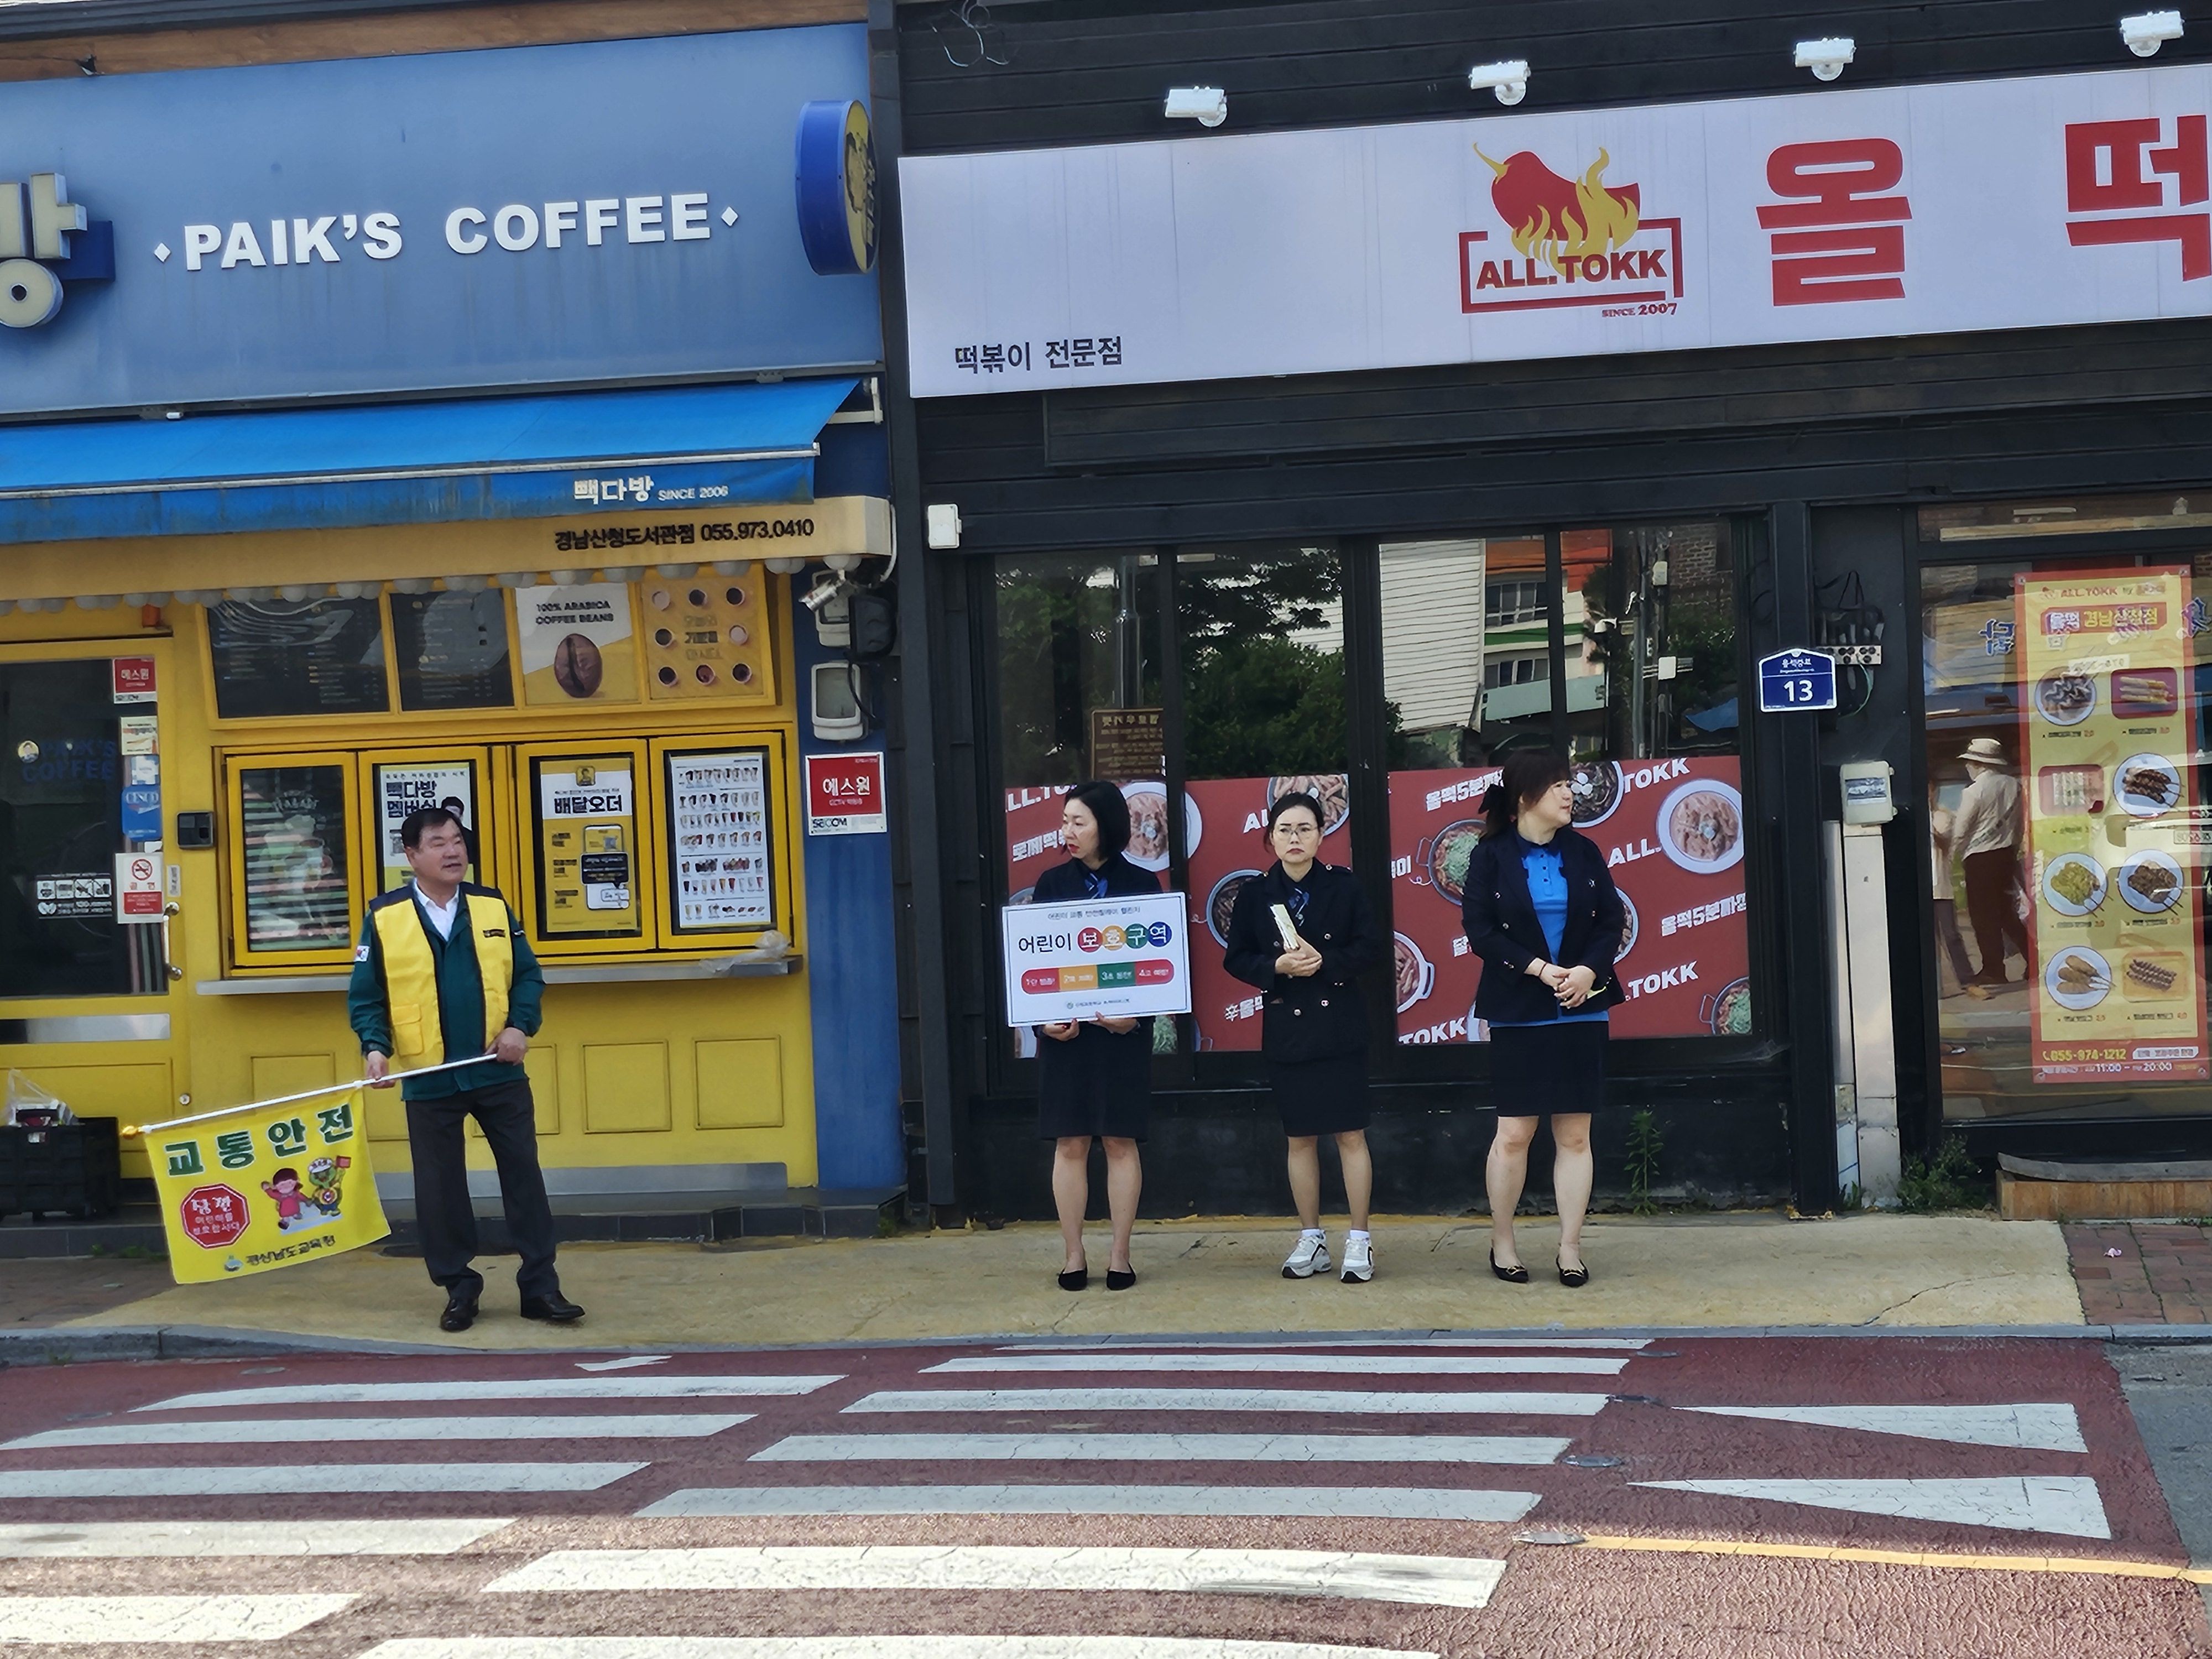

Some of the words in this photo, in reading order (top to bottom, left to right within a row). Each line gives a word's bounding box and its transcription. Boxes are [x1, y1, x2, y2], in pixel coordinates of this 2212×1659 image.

[184, 211, 403, 271] PAIK'S
[445, 192, 712, 254] COFFEE
[1476, 249, 1667, 290] ALL.TOKK
[1601, 307, 1635, 317] SINCE
[1638, 303, 1678, 316] 2007
[955, 341, 1031, 374] 떡볶이
[1045, 336, 1122, 368] 전문점
[658, 488, 695, 502] SINCE
[701, 518, 815, 542] 055.973.0410
[565, 601, 611, 611] ARABICA
[535, 615, 576, 624] COFFEE
[579, 613, 614, 623] BEANS
[1783, 680, 1814, 702] 13
[822, 775, 870, 796] 에스원
[554, 795, 623, 814] 배달오더
[812, 817, 847, 828] SECOM
[1018, 932, 1072, 954] 어린이
[1081, 925, 1167, 948] 보호구역
[164, 1103, 354, 1177] 교통안전
